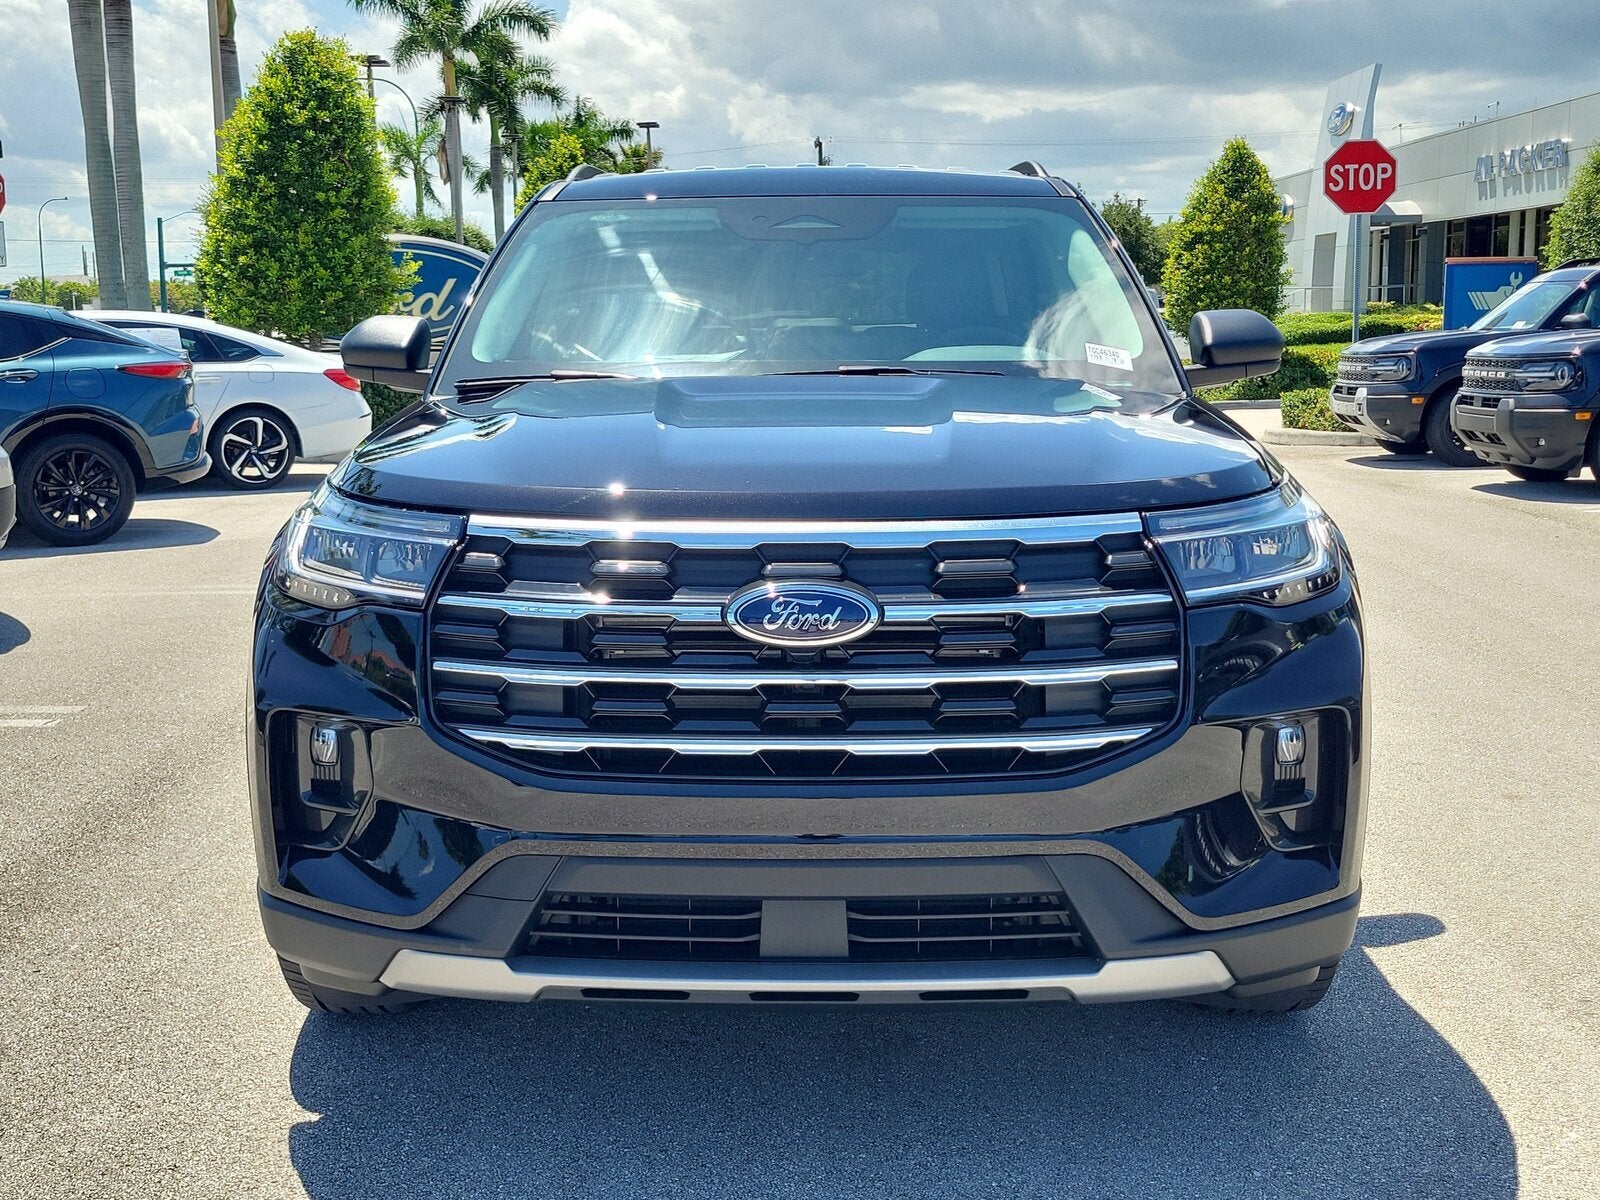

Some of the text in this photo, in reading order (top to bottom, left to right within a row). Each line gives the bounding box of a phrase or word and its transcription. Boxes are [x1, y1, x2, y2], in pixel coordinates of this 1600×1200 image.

[1497, 138, 1570, 178] PACKER
[1328, 163, 1392, 191] STOP
[763, 597, 842, 630] Ford
